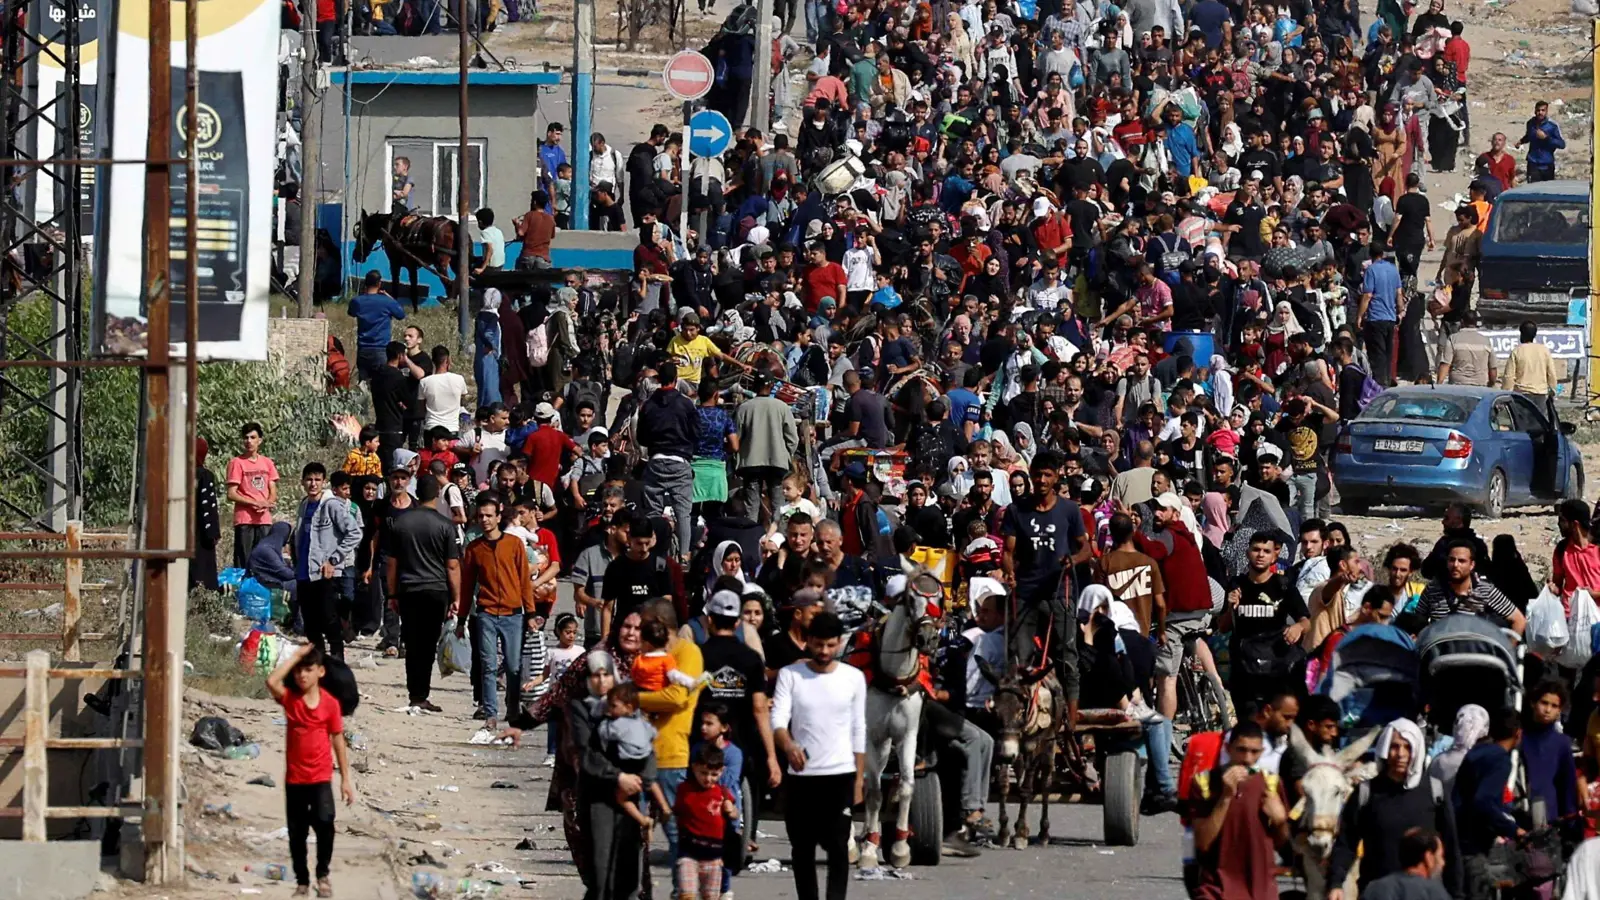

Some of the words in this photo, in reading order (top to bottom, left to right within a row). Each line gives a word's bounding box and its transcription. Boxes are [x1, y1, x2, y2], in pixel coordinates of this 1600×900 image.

[1489, 337, 1519, 352] LICE
[1542, 335, 1576, 353] شرط
[1108, 565, 1152, 600] NIKE
[1238, 604, 1275, 617] PUMA
